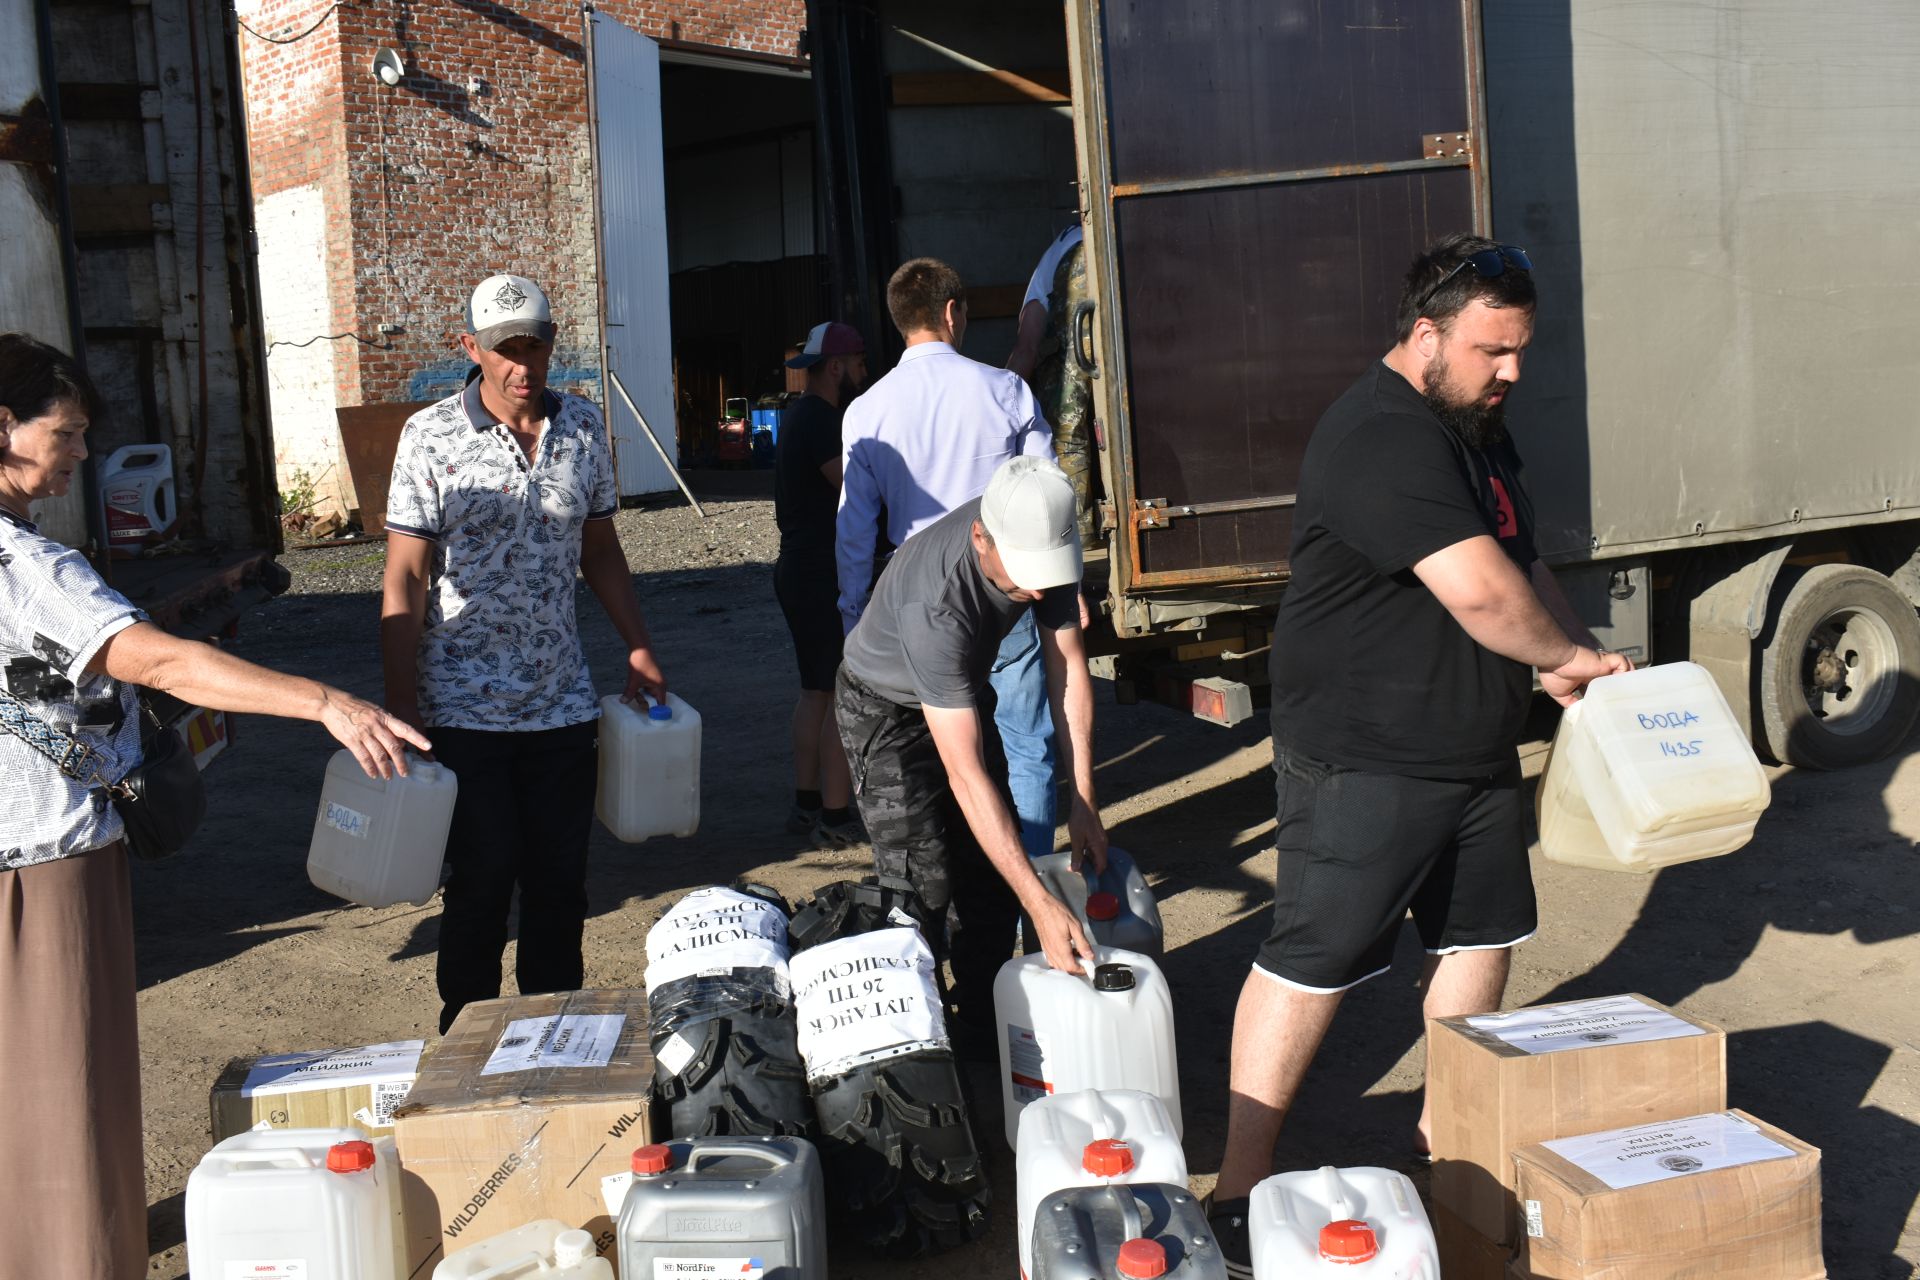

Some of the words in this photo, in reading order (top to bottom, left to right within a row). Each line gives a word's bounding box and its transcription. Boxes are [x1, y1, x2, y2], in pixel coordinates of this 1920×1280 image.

[1637, 710, 1699, 730] ВОДА
[1659, 740, 1703, 757] 1435
[326, 803, 360, 832] ВОДА
[689, 919, 708, 931] 26
[828, 984, 859, 1004] ТП
[863, 977, 885, 996] 26
[294, 1060, 373, 1073] МЕЙДЖИК
[444, 1152, 522, 1237] WILDBERRIES
[595, 1230, 616, 1257] IES
[676, 1263, 716, 1272] NordFire
